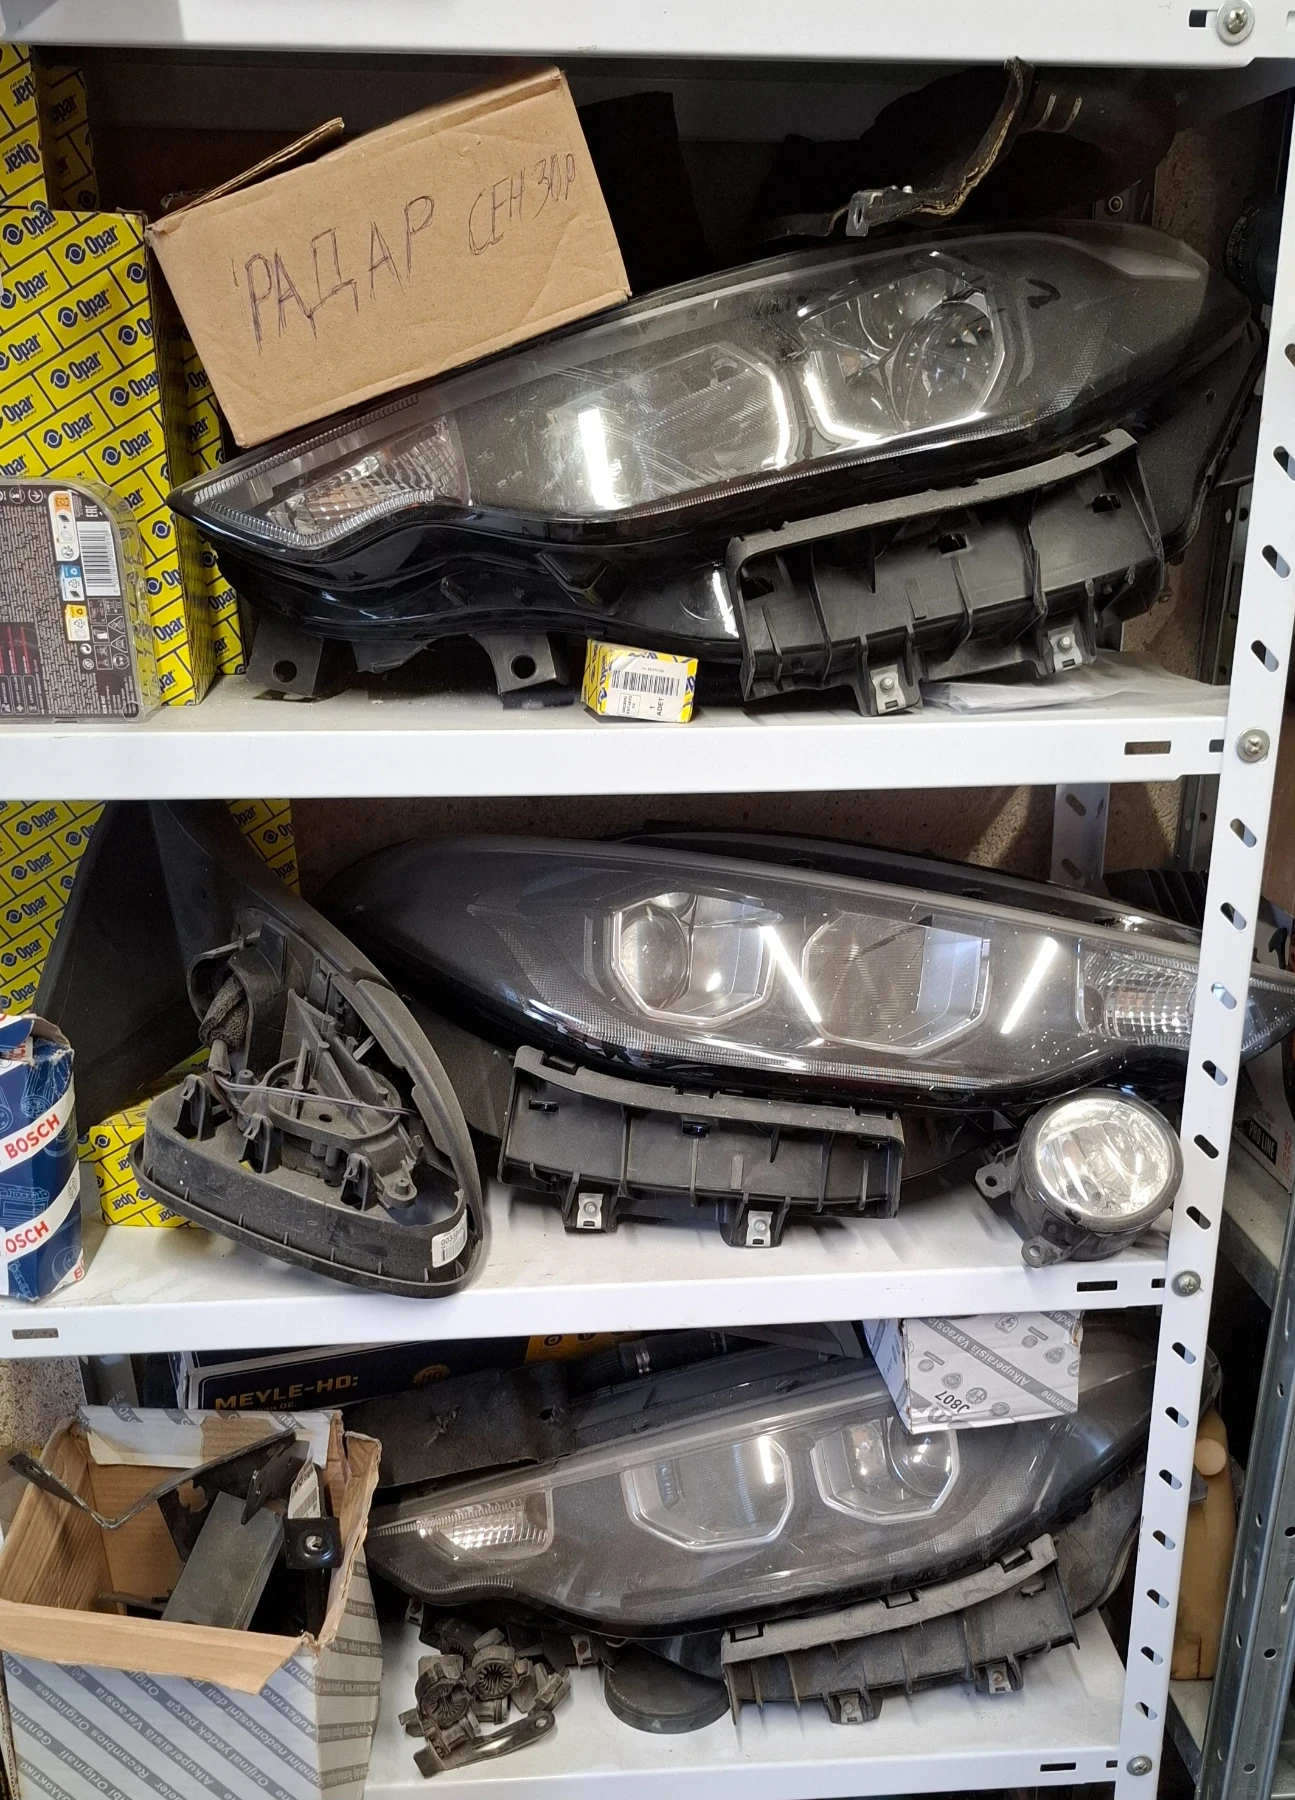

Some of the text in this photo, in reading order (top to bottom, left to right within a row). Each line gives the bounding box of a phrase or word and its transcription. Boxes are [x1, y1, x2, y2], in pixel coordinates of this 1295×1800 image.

[4, 143, 39, 174] Opar
[21, 208, 56, 236] Opar
[84, 226, 118, 255] Opar
[14, 271, 47, 299] Opar
[244, 196, 434, 354] РАДАР
[76, 290, 109, 318] Opar
[8, 334, 41, 362] Opar
[68, 352, 101, 380] Opar
[2, 395, 34, 422] Opar
[61, 412, 93, 440] Opar
[120, 429, 152, 457] Opar
[209, 587, 237, 611] Opar
[153, 615, 183, 641] Opar
[31, 807, 57, 830] Opar
[26, 850, 52, 875] Opar
[22, 895, 46, 918] Opar
[16, 938, 41, 961] Opar
[11, 981, 36, 1003] Opar
[4, 1113, 61, 1160] BOSCH
[112, 1191, 137, 1212] Opar
[968, 1343, 1032, 1389] Alkuperäisiä
[934, 1391, 970, 1414] J807
[93, 1686, 146, 1730] Varaosia
[205, 1687, 228, 1709] deli
[165, 1697, 200, 1728] parça
[33, 1682, 150, 1780] Recambios Originales
[197, 1725, 232, 1756] yedek
[224, 1703, 289, 1758] nadomestni
[58, 1747, 111, 1792] Originali
